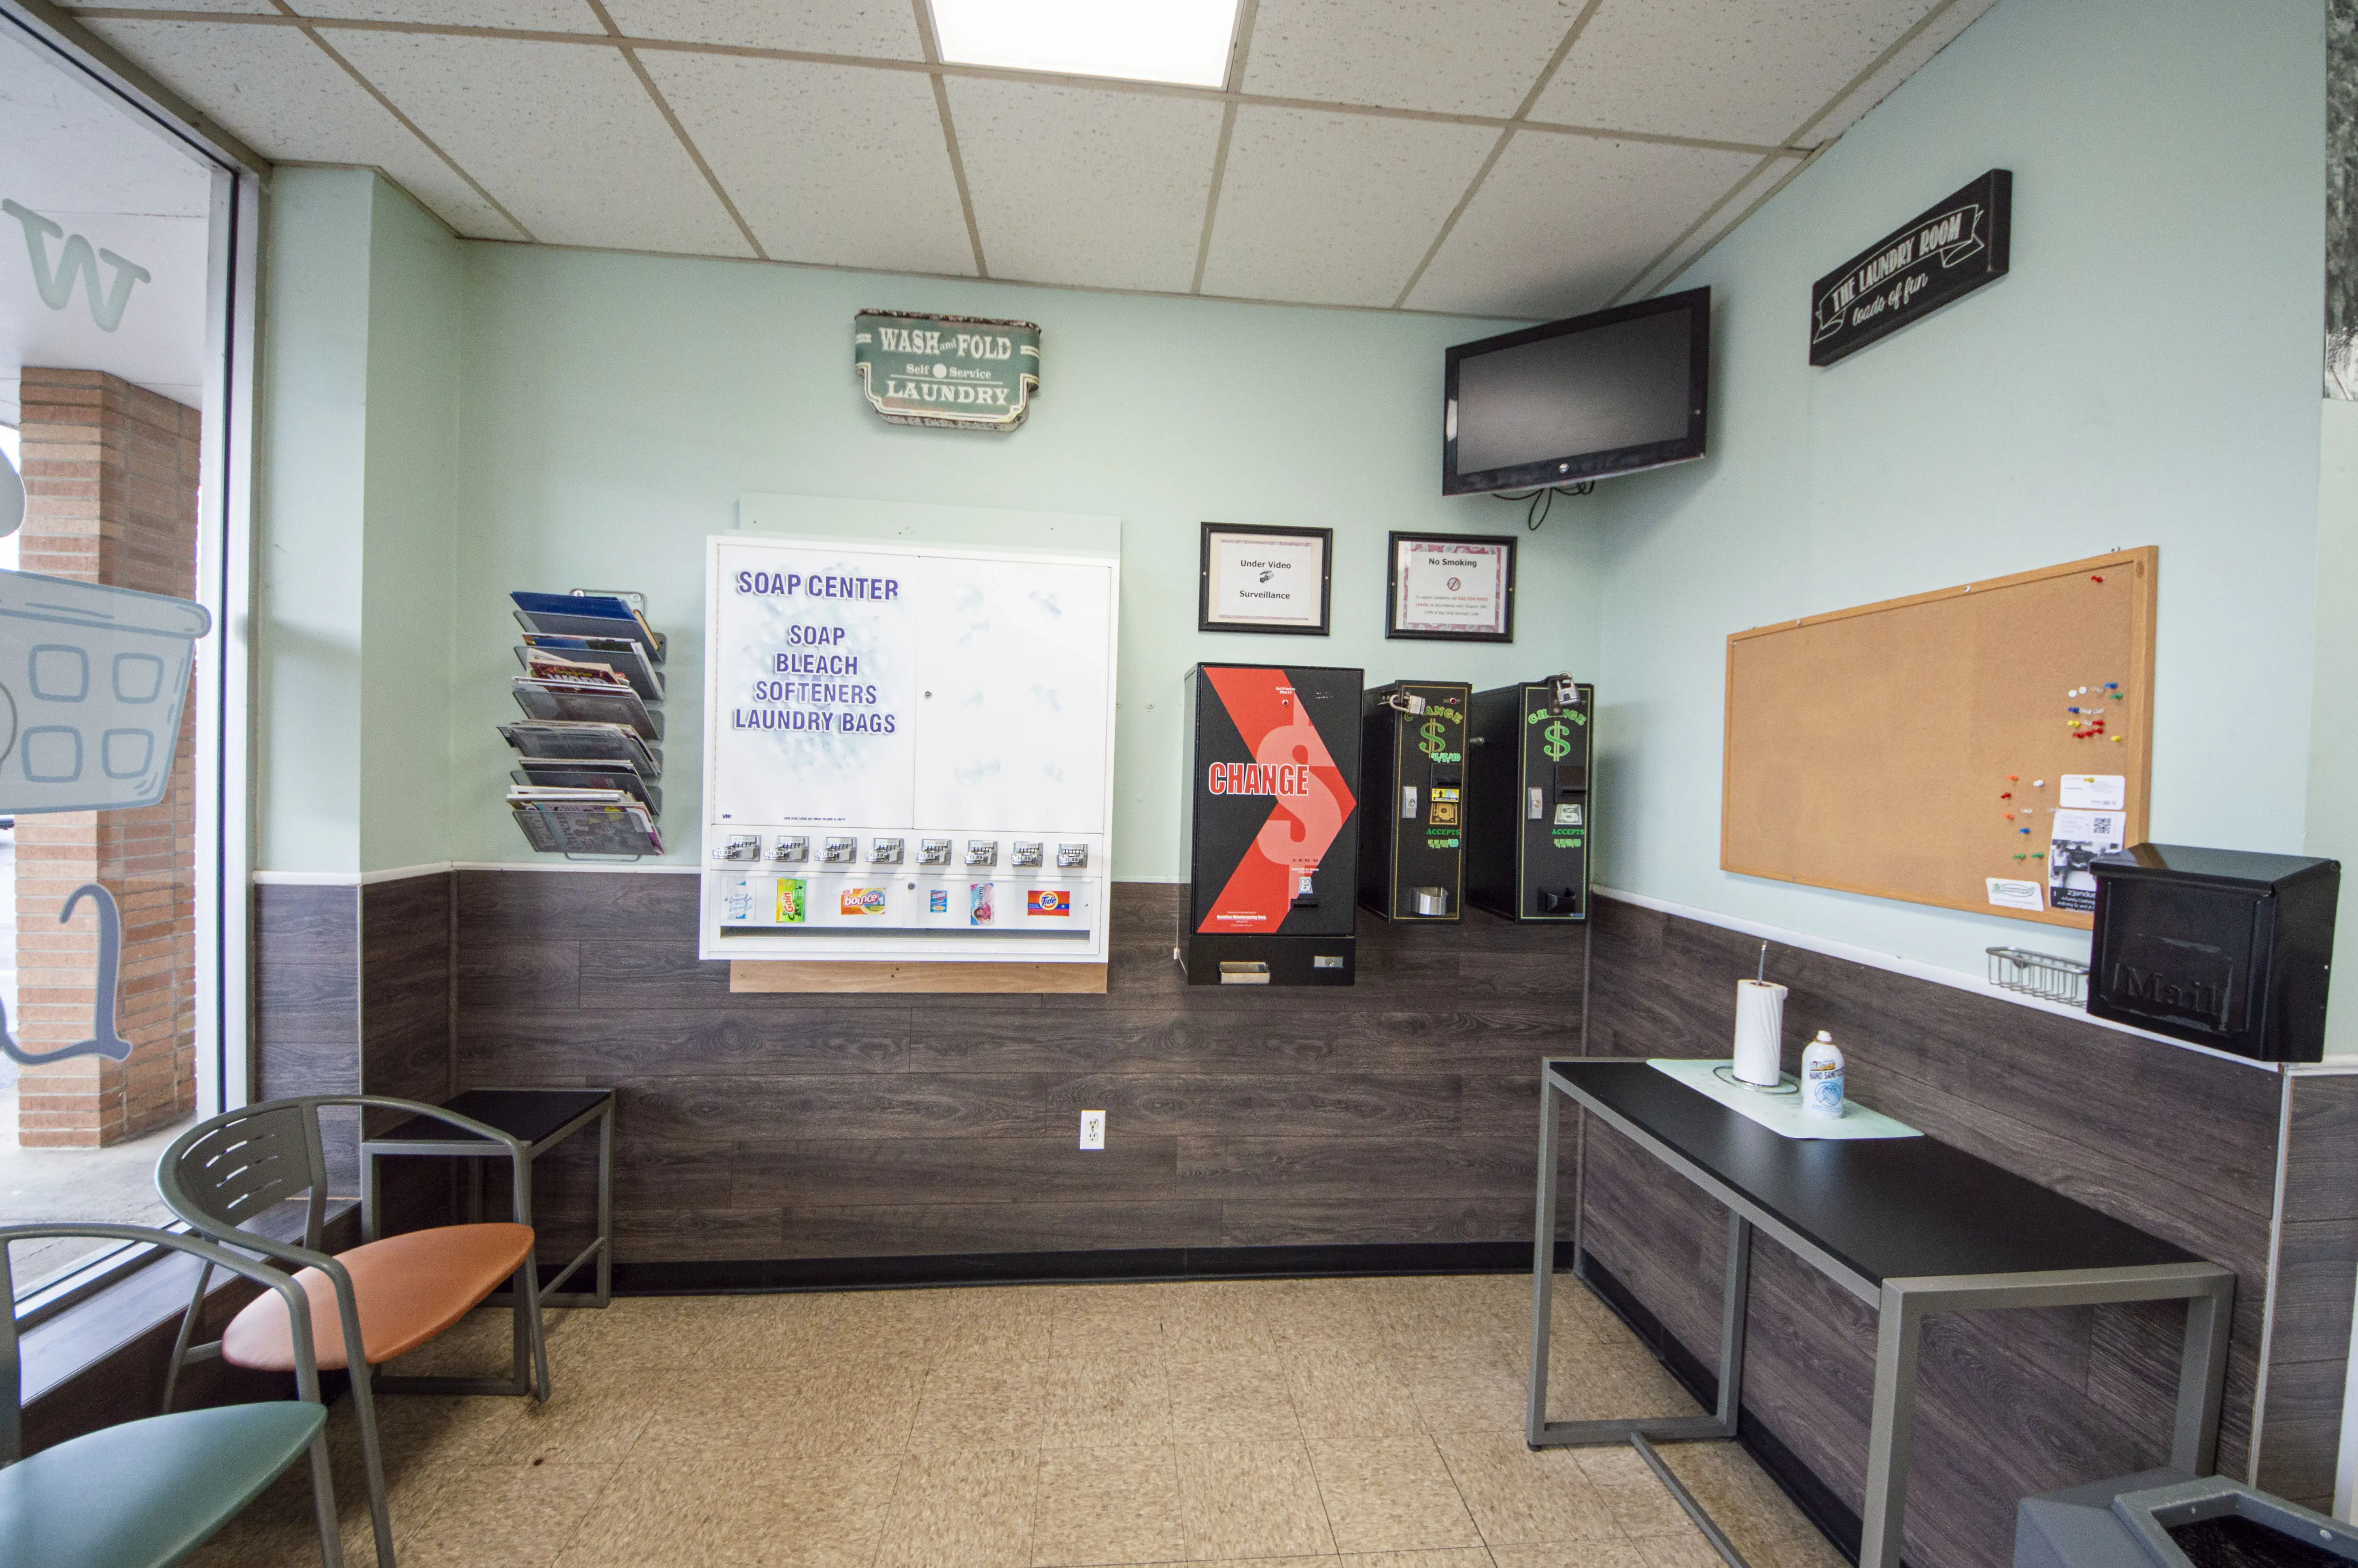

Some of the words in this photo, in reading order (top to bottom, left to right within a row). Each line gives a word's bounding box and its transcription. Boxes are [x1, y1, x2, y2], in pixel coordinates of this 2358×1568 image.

[1832, 277, 1855, 312] THE
[1859, 236, 1915, 292] LAUNDRY
[1920, 213, 1962, 256] ROOM
[1853, 295, 1886, 326] loads
[1888, 282, 1902, 310] of
[1904, 273, 1928, 304] fun
[879, 327, 941, 355] WASH
[941, 338, 956, 351] and
[957, 334, 1011, 359] FOLD
[906, 364, 929, 375] Self
[950, 367, 991, 379] Service
[886, 380, 1010, 405] LAUNDRY
[1442, 559, 1477, 568] Smoking
[739, 571, 801, 595] SOAP
[809, 575, 899, 600] CENTER
[1239, 590, 1290, 599] Surveillance
[790, 625, 845, 646] SOAP
[776, 653, 858, 675] BLEACH
[756, 681, 877, 704] SOFTENERS
[736, 709, 833, 731] LAUNDRY
[842, 712, 895, 733] BAGS
[1404, 705, 1463, 724] CANGE
[1528, 709, 1587, 726] CHNGE
[1209, 762, 1309, 796] CHANGE
[784, 892, 795, 913] Gain
[844, 894, 878, 906] bounce
[1041, 896, 1056, 907] Tide
[2124, 967, 2217, 1016] Mail
